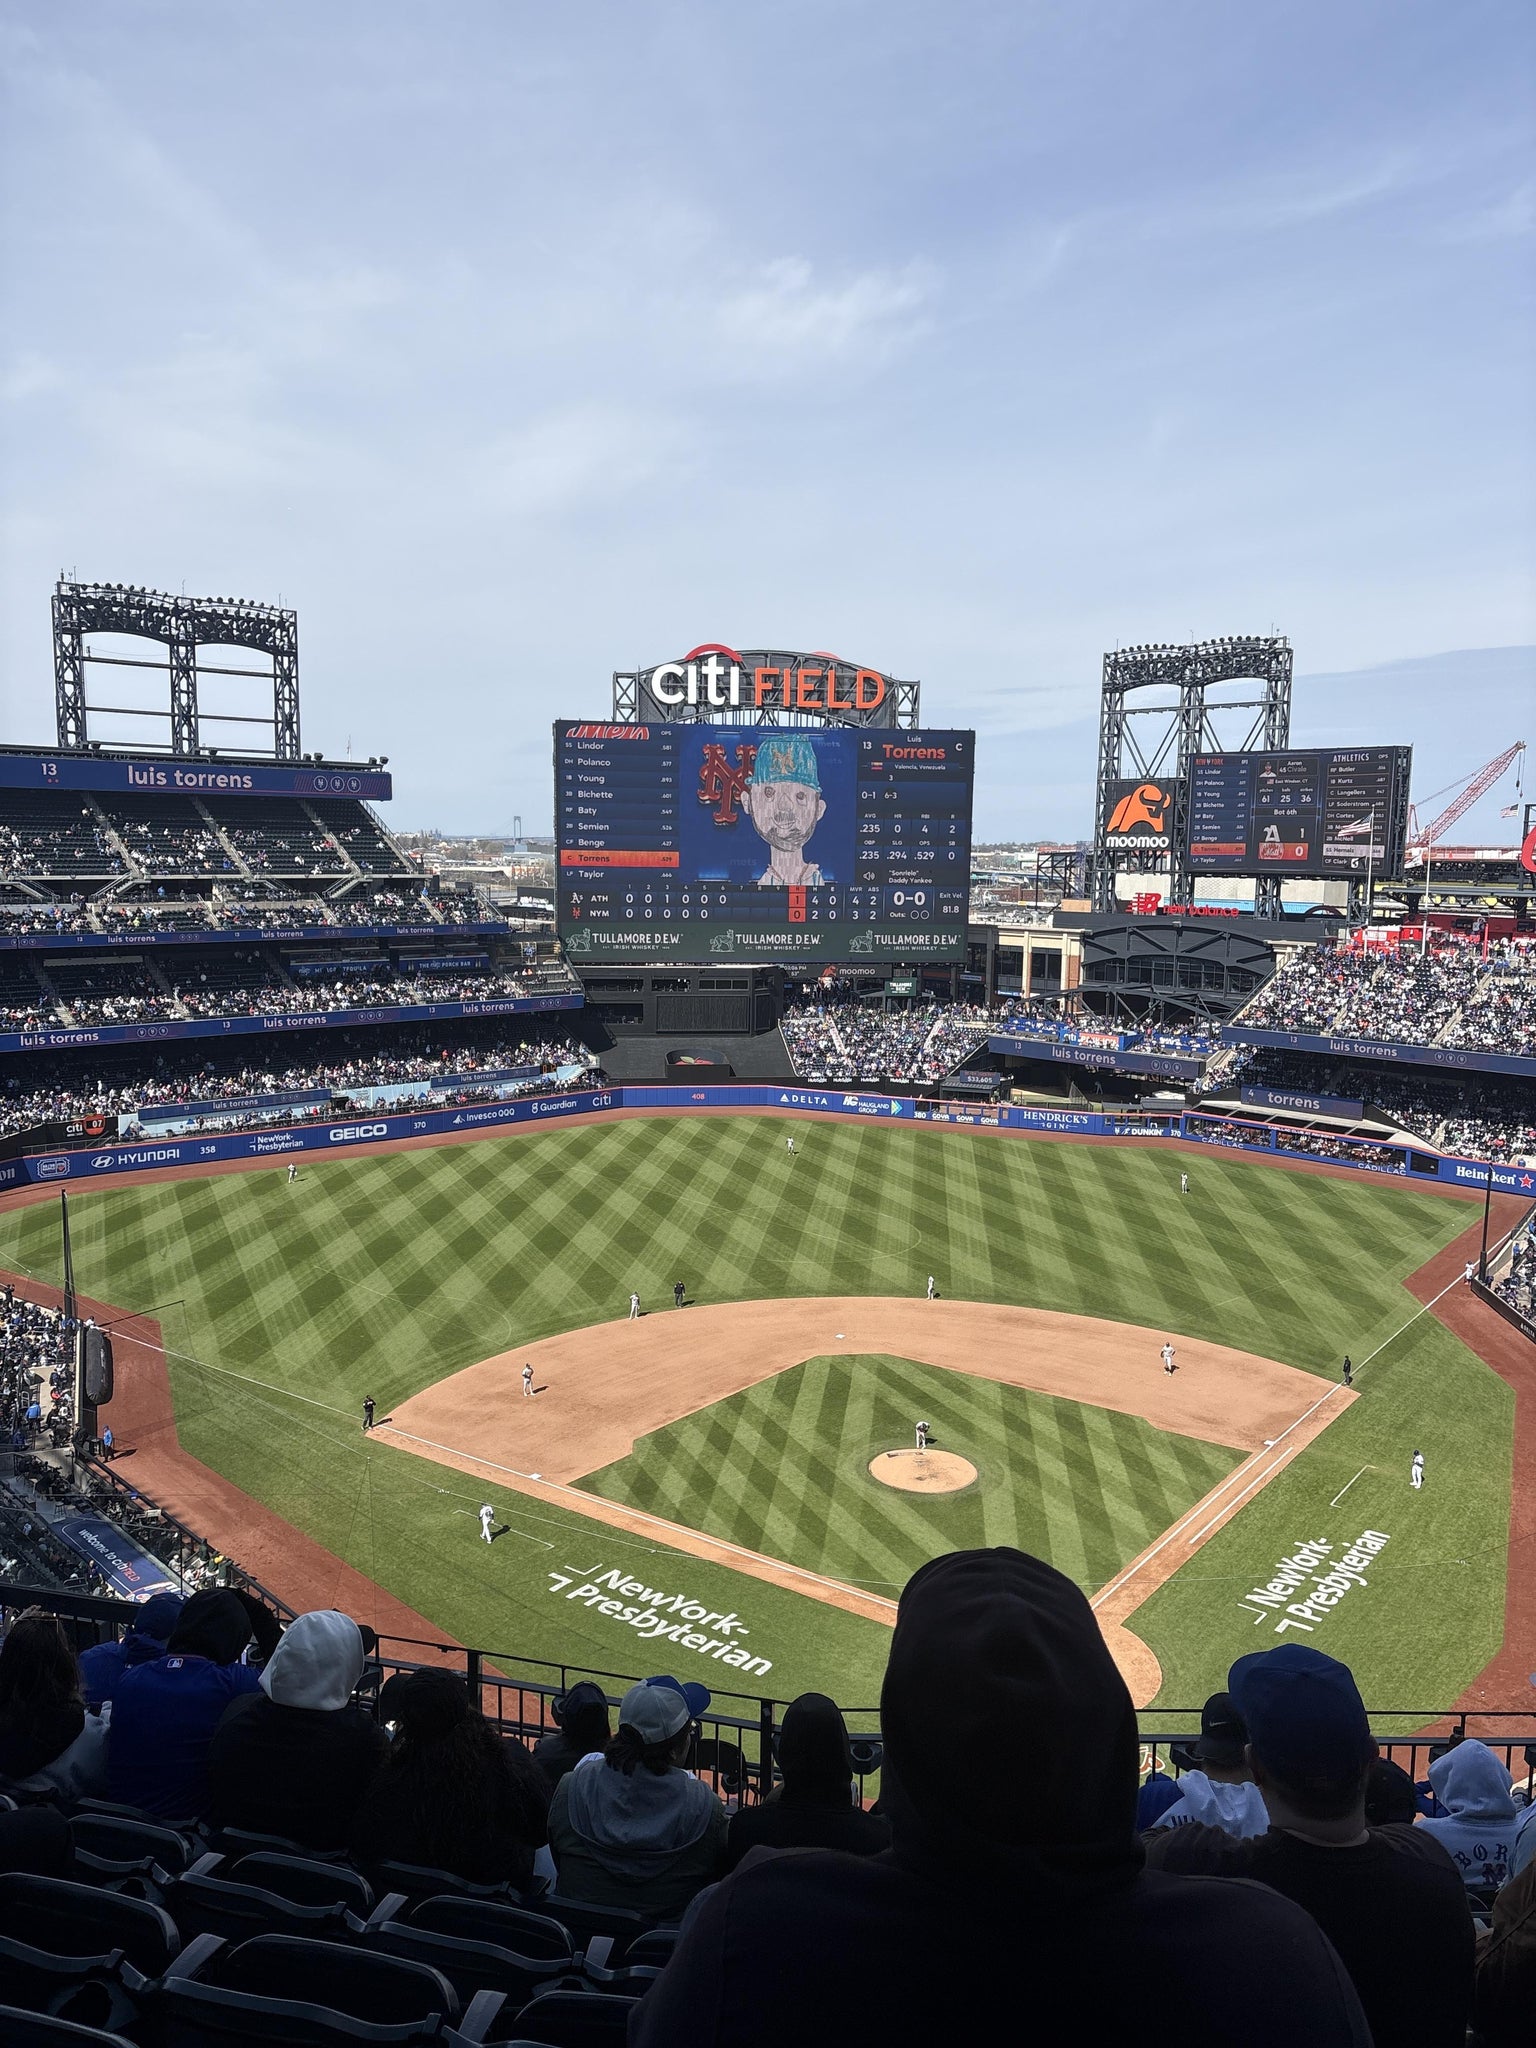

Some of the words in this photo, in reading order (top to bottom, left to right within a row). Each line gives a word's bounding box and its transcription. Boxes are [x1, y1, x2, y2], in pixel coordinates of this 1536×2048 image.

[651, 655, 740, 705] citi
[755, 668, 884, 709] FIELD
[577, 742, 604, 750] Lindor
[882, 744, 945, 759] Torrens
[956, 743, 962, 751] C
[1333, 753, 1369, 762] ATHLETICS
[41, 763, 57, 776] 13
[128, 765, 166, 785] luis
[174, 769, 253, 788] torrens
[578, 775, 605, 784] Young
[1262, 795, 1270, 803] 61
[1280, 795, 1291, 803] 25
[578, 807, 597, 816] Baty
[860, 825, 880, 833] .235
[921, 825, 928, 833] 4
[949, 825, 955, 834] 2
[579, 839, 605, 848] Benge
[1106, 836, 1169, 848] moomoo
[859, 851, 880, 860] .235
[887, 851, 907, 860] .294
[914, 852, 934, 860] .529
[579, 870, 604, 879] Taylor
[812, 896, 819, 905] 4
[853, 896, 859, 905] 4
[871, 896, 877, 905] 2
[894, 891, 926, 906] 0-0
[812, 911, 819, 920] 2
[853, 911, 859, 920] 3
[870, 911, 876, 920] 2
[1163, 905, 1185, 914] new
[1189, 904, 1239, 916] balance
[108, 935, 123, 943] luis
[126, 935, 157, 943] torrens
[262, 931, 275, 939] luis
[592, 933, 652, 944] TULLAMORE
[655, 934, 681, 944] D.E.W.
[736, 934, 793, 944] TULLAMORE
[796, 935, 822, 945] D.E.W.
[875, 935, 931, 945] TULLAMORE
[934, 935, 959, 945] D.E.W.
[463, 1004, 479, 1014] luis
[482, 1002, 515, 1012] torrens
[223, 1021, 231, 1029] 13
[264, 1017, 283, 1028] luis
[286, 1015, 326, 1027] torrens
[21, 1035, 46, 1047] luis
[50, 1032, 100, 1044] torrens
[1330, 1039, 1350, 1052] luis
[1354, 1041, 1398, 1057] torrens
[1052, 1046, 1071, 1059] luis
[1074, 1050, 1116, 1065] torrens
[229, 1098, 259, 1108] torrens
[593, 1094, 612, 1107] citi
[792, 1095, 828, 1105] DELTA
[843, 1096, 860, 1106] HG
[1248, 1089, 1254, 1097] 4
[1268, 1091, 1320, 1109] torrens
[540, 1101, 577, 1112] Guardian
[466, 1111, 497, 1122] Invesco
[499, 1108, 515, 1117] QQQ
[914, 1111, 926, 1119] 380
[1023, 1111, 1088, 1124] HENDRICK'S
[66, 1122, 83, 1133] citi
[92, 1120, 102, 1128] 07
[414, 1121, 426, 1129] 370
[330, 1124, 388, 1141] GEICO
[1131, 1127, 1163, 1136] DUNKIN'
[257, 1135, 294, 1144] NewYork-
[1202, 1137, 1244, 1149] CADILLAC
[200, 1145, 216, 1155] 358
[257, 1140, 304, 1152] Presbyterian
[118, 1148, 179, 1165] HYUNDAI
[1358, 1162, 1407, 1175] CADILLAC
[78, 1529, 109, 1554] welcome
[105, 1551, 117, 1561] to
[1245, 1537, 1333, 1609] NewYork-
[1285, 1529, 1391, 1622] Presbyterian
[594, 1569, 750, 1636] NewYork-
[565, 1583, 773, 1677] Presbyterian
